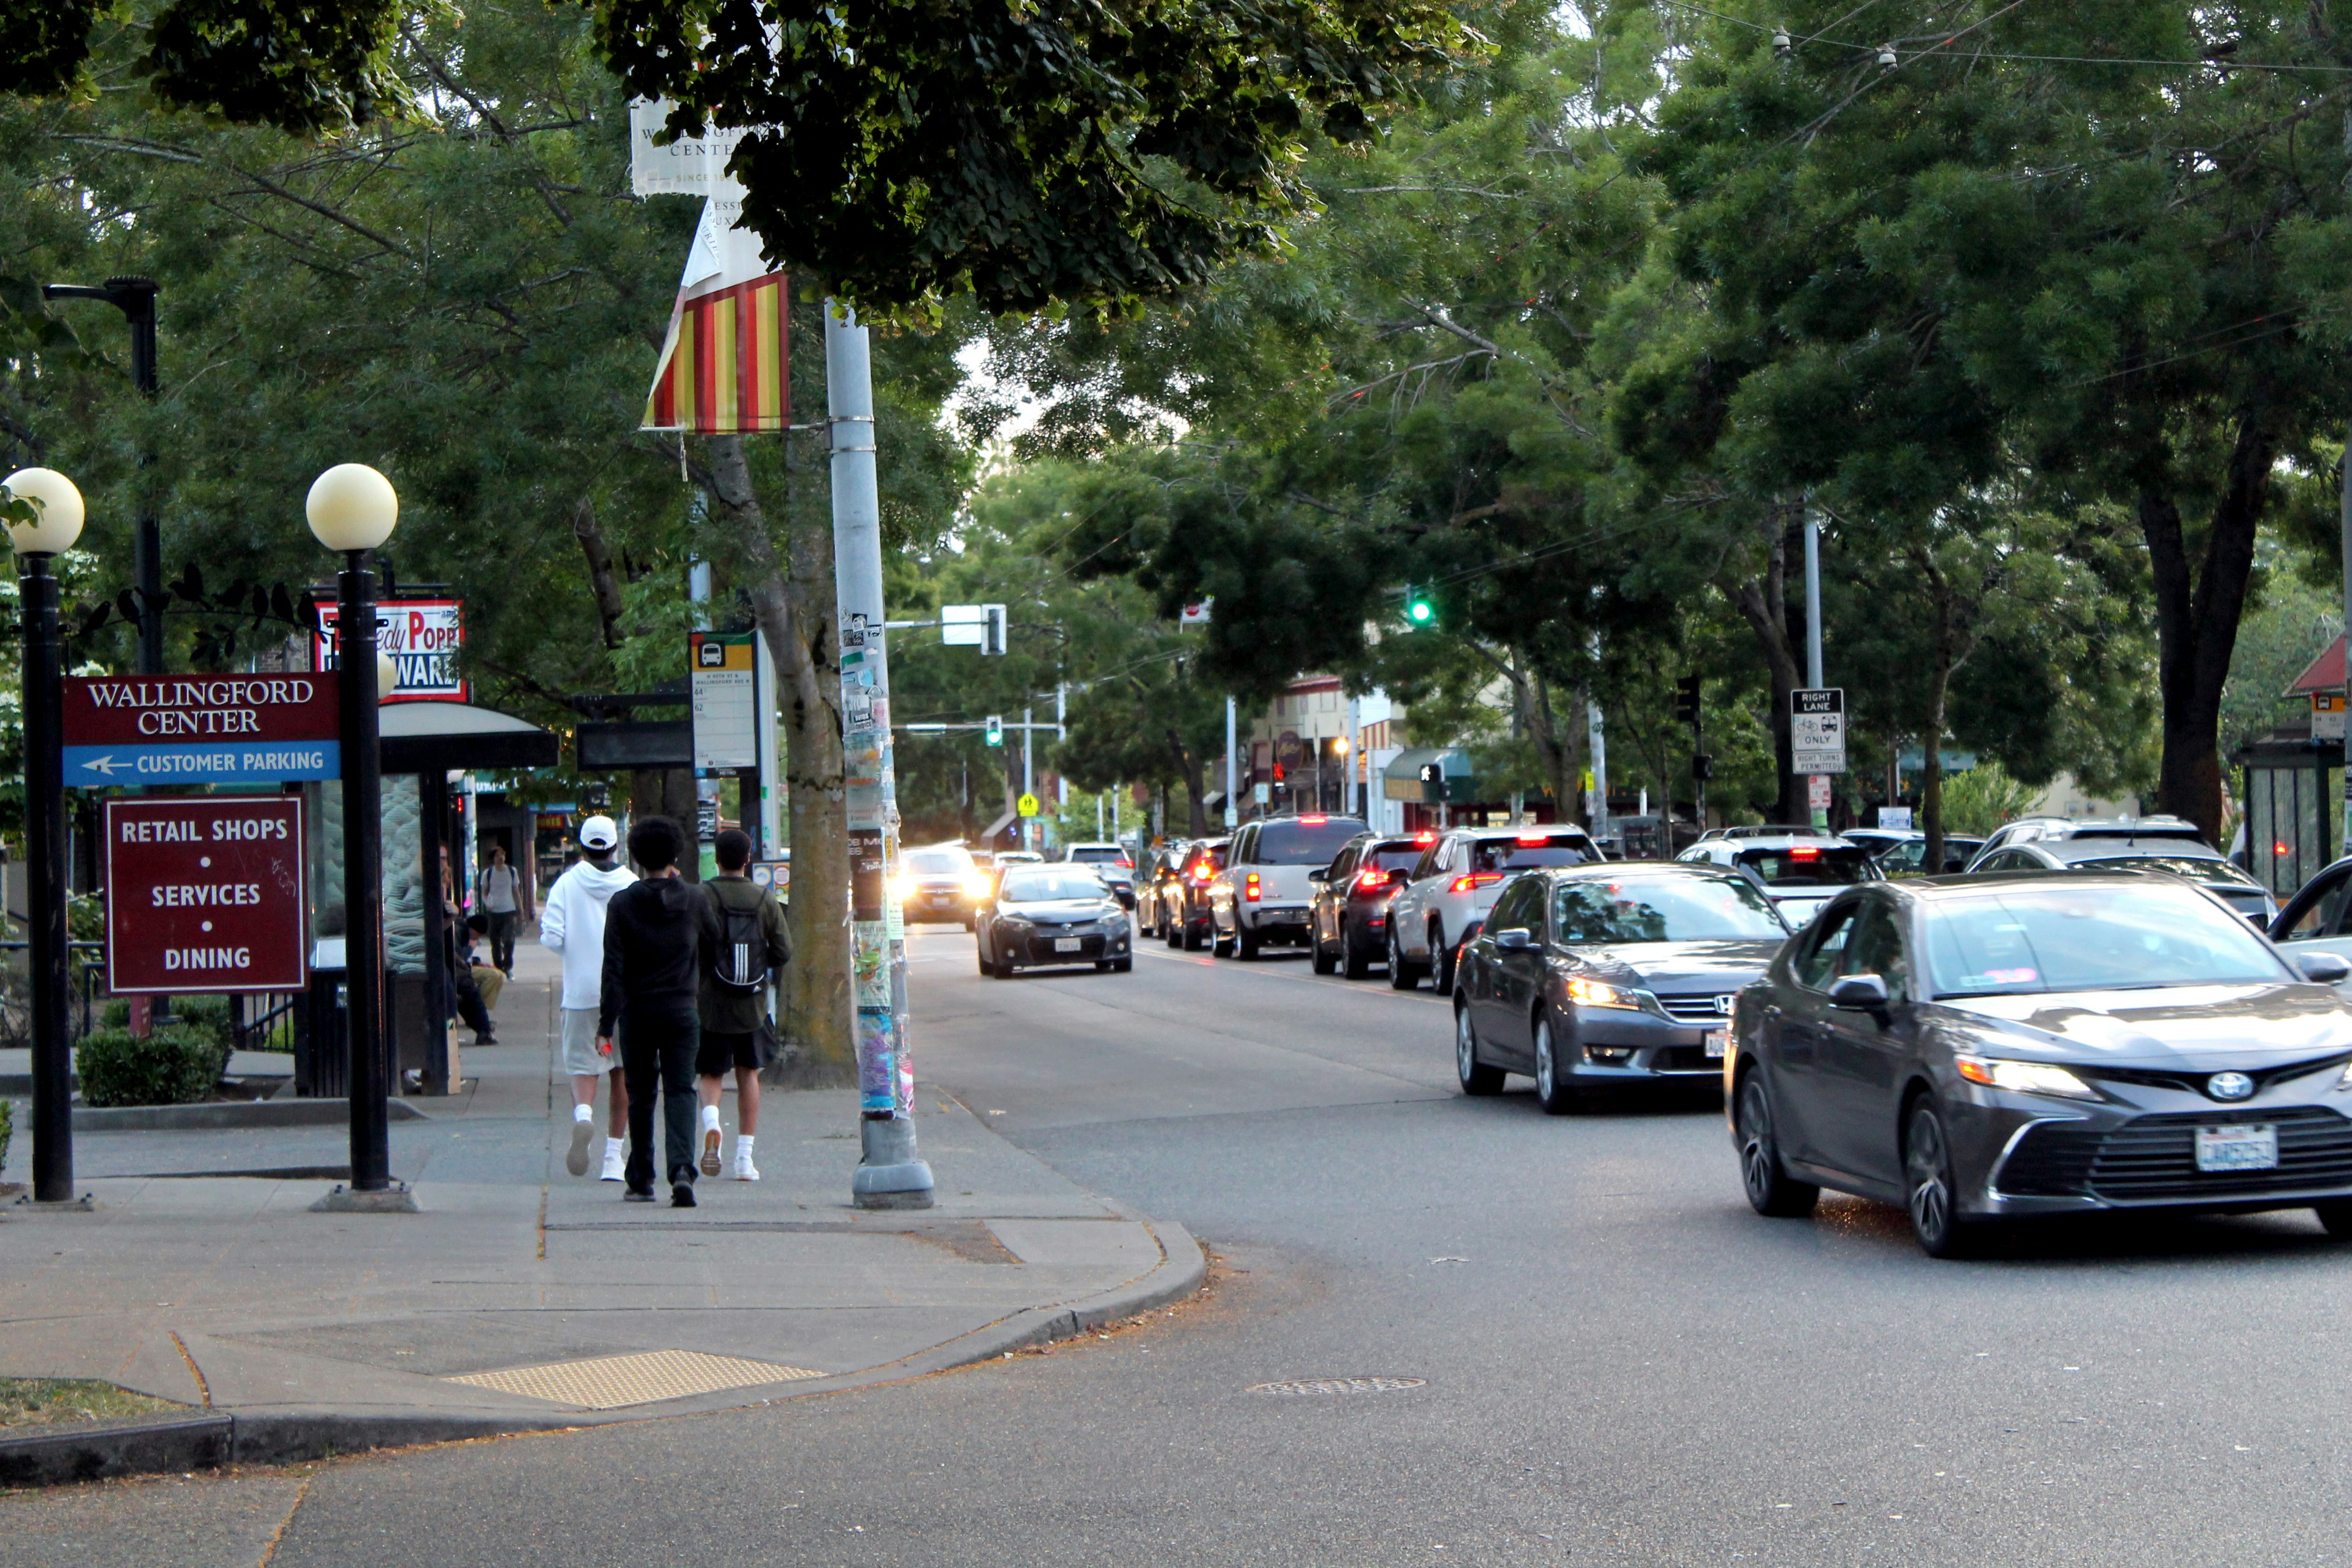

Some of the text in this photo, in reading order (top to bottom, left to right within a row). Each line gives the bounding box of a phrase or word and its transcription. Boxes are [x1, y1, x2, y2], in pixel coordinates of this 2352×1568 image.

[671, 144, 732, 156] CENTE
[677, 174, 709, 182] SINCE
[88, 680, 313, 707] WALLINGFORD
[1801, 693, 1832, 702] RIGHT
[1804, 702, 1831, 711] LANE
[138, 710, 260, 735] CENTER
[1805, 736, 1831, 744] ONLY
[137, 751, 324, 774] CUSTOMER PARKING
[1797, 754, 1817, 763] RIGHT
[1801, 763, 1837, 771] PERMITTED
[122, 819, 288, 843] RETAIL SHOPS
[152, 884, 260, 907] SERVICES
[165, 947, 251, 971] DINING
